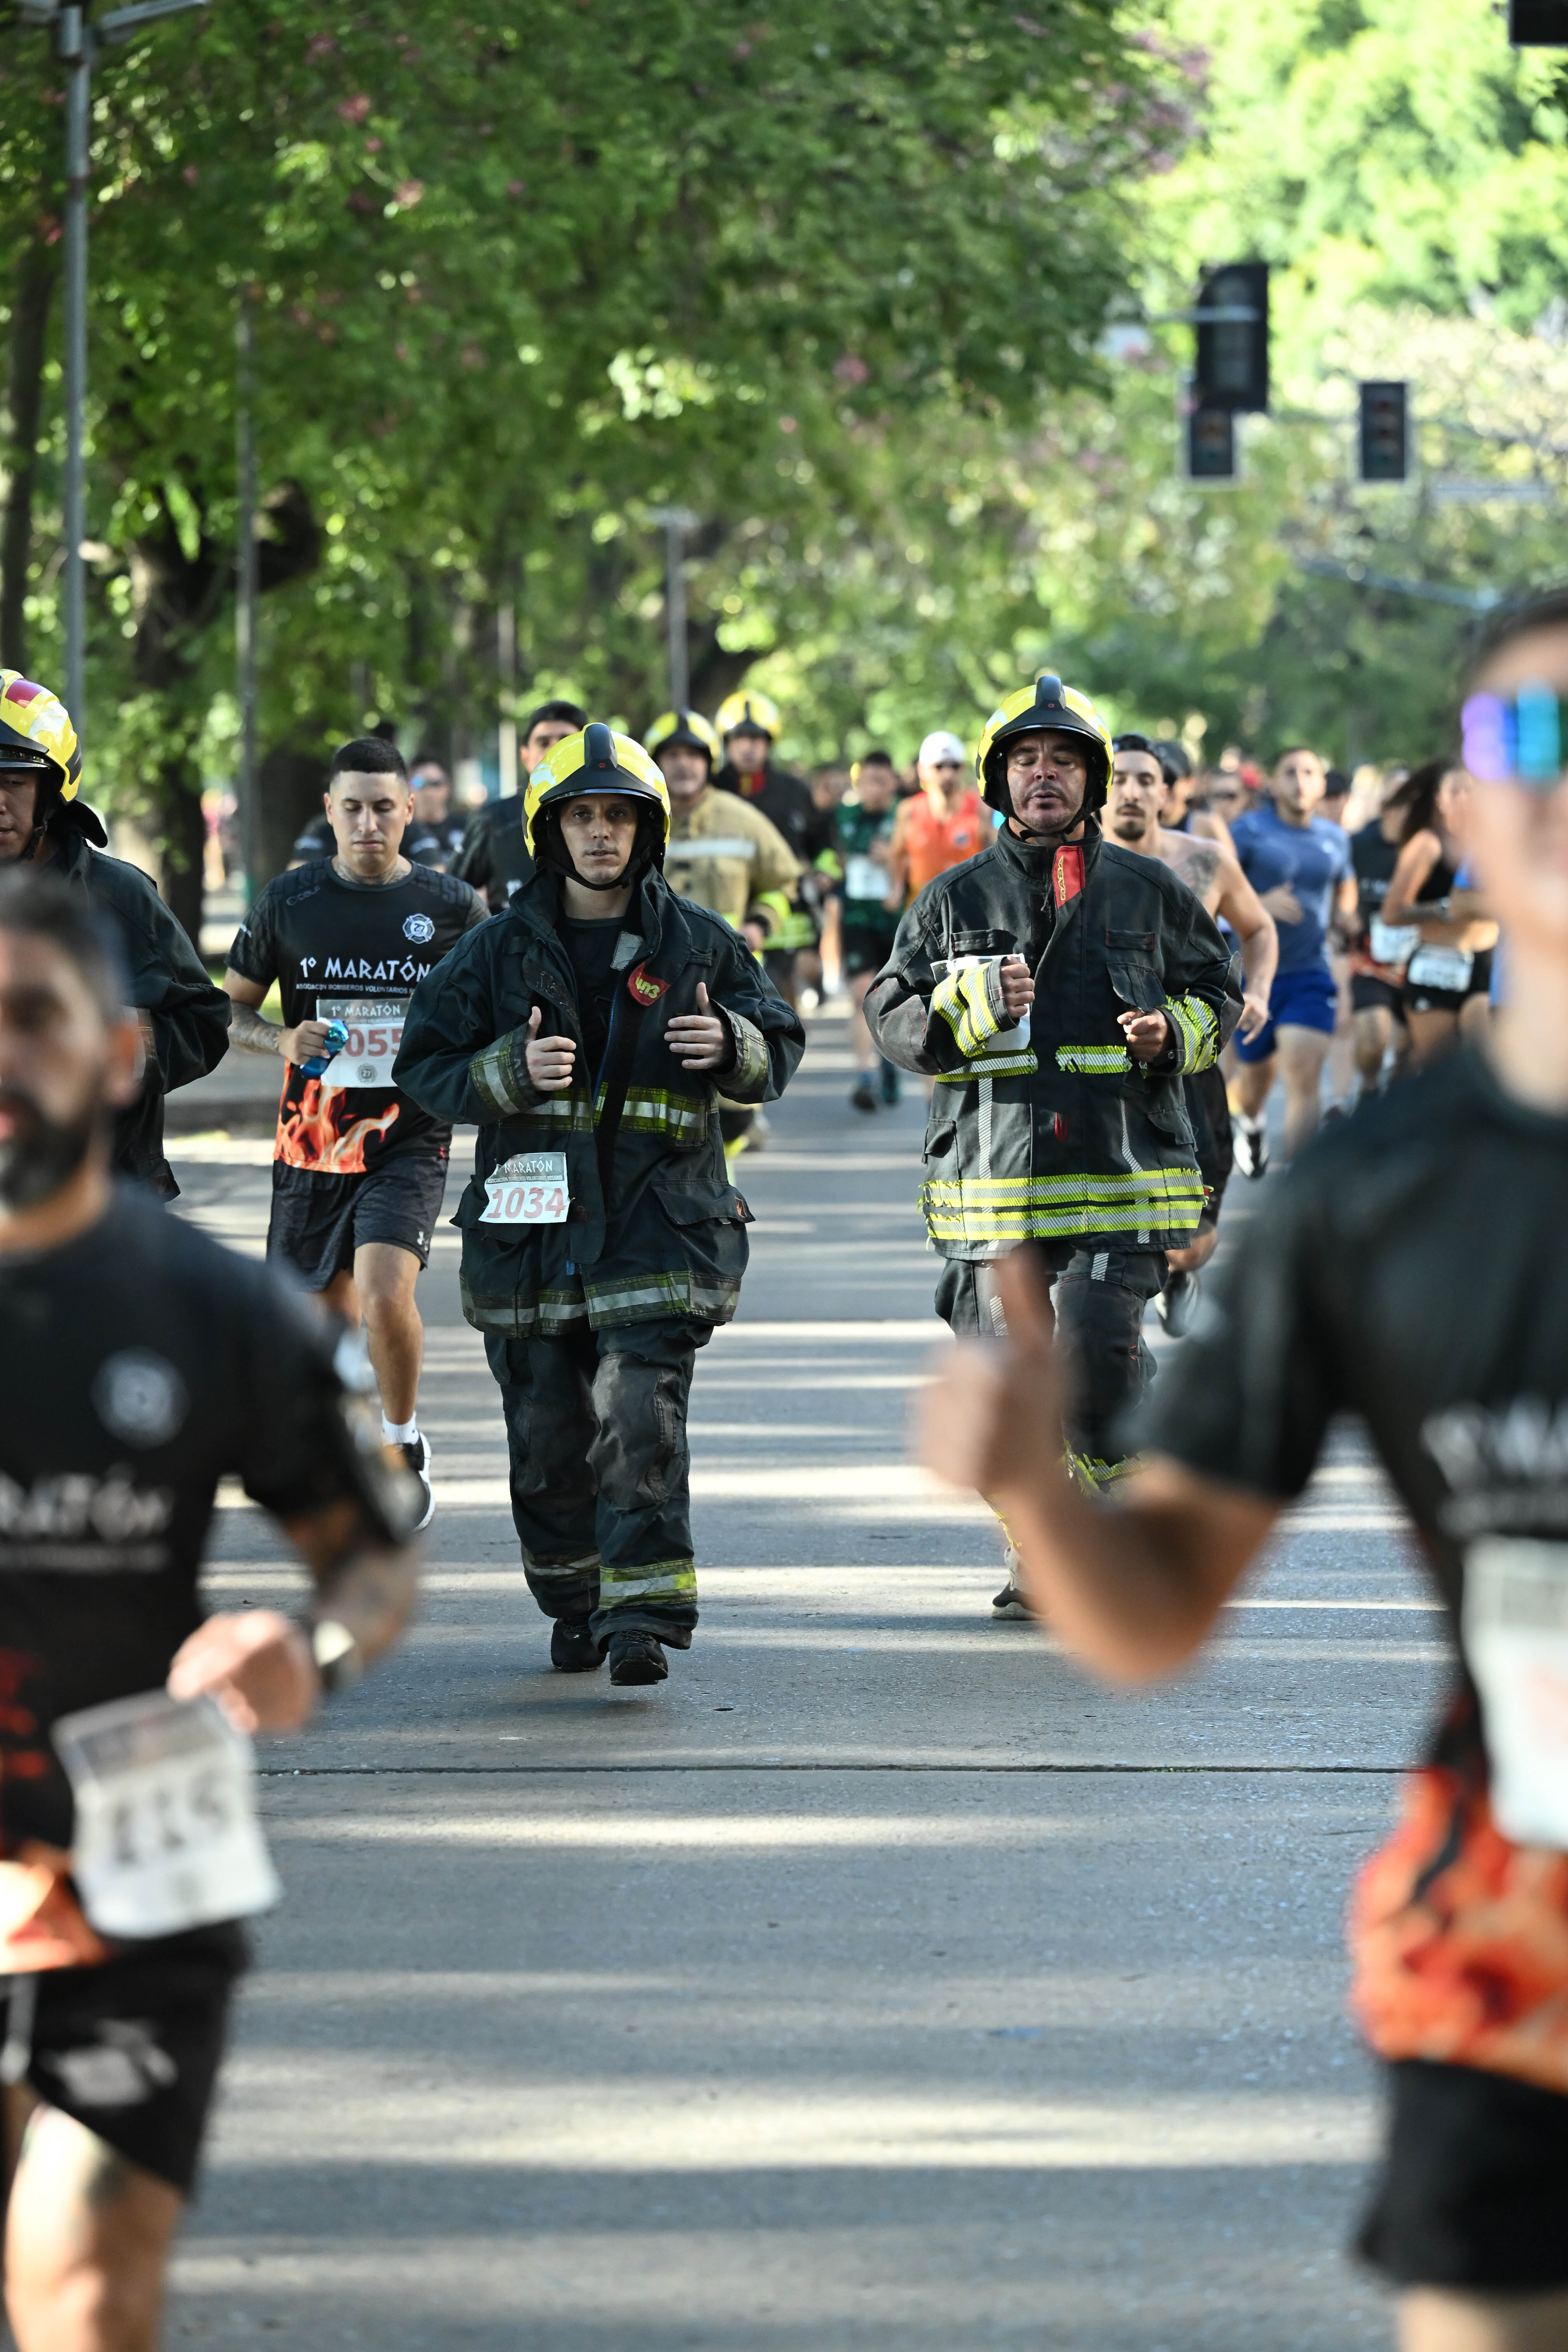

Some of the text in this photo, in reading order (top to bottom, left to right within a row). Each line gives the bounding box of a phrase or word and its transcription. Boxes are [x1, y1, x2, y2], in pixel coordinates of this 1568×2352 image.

[414, 923, 425, 932] 27
[324, 954, 430, 982] MARATÓN
[345, 1002, 400, 1016] MARATÓN
[504, 1157, 552, 1174] MARATÓN
[486, 1187, 566, 1219] 1034
